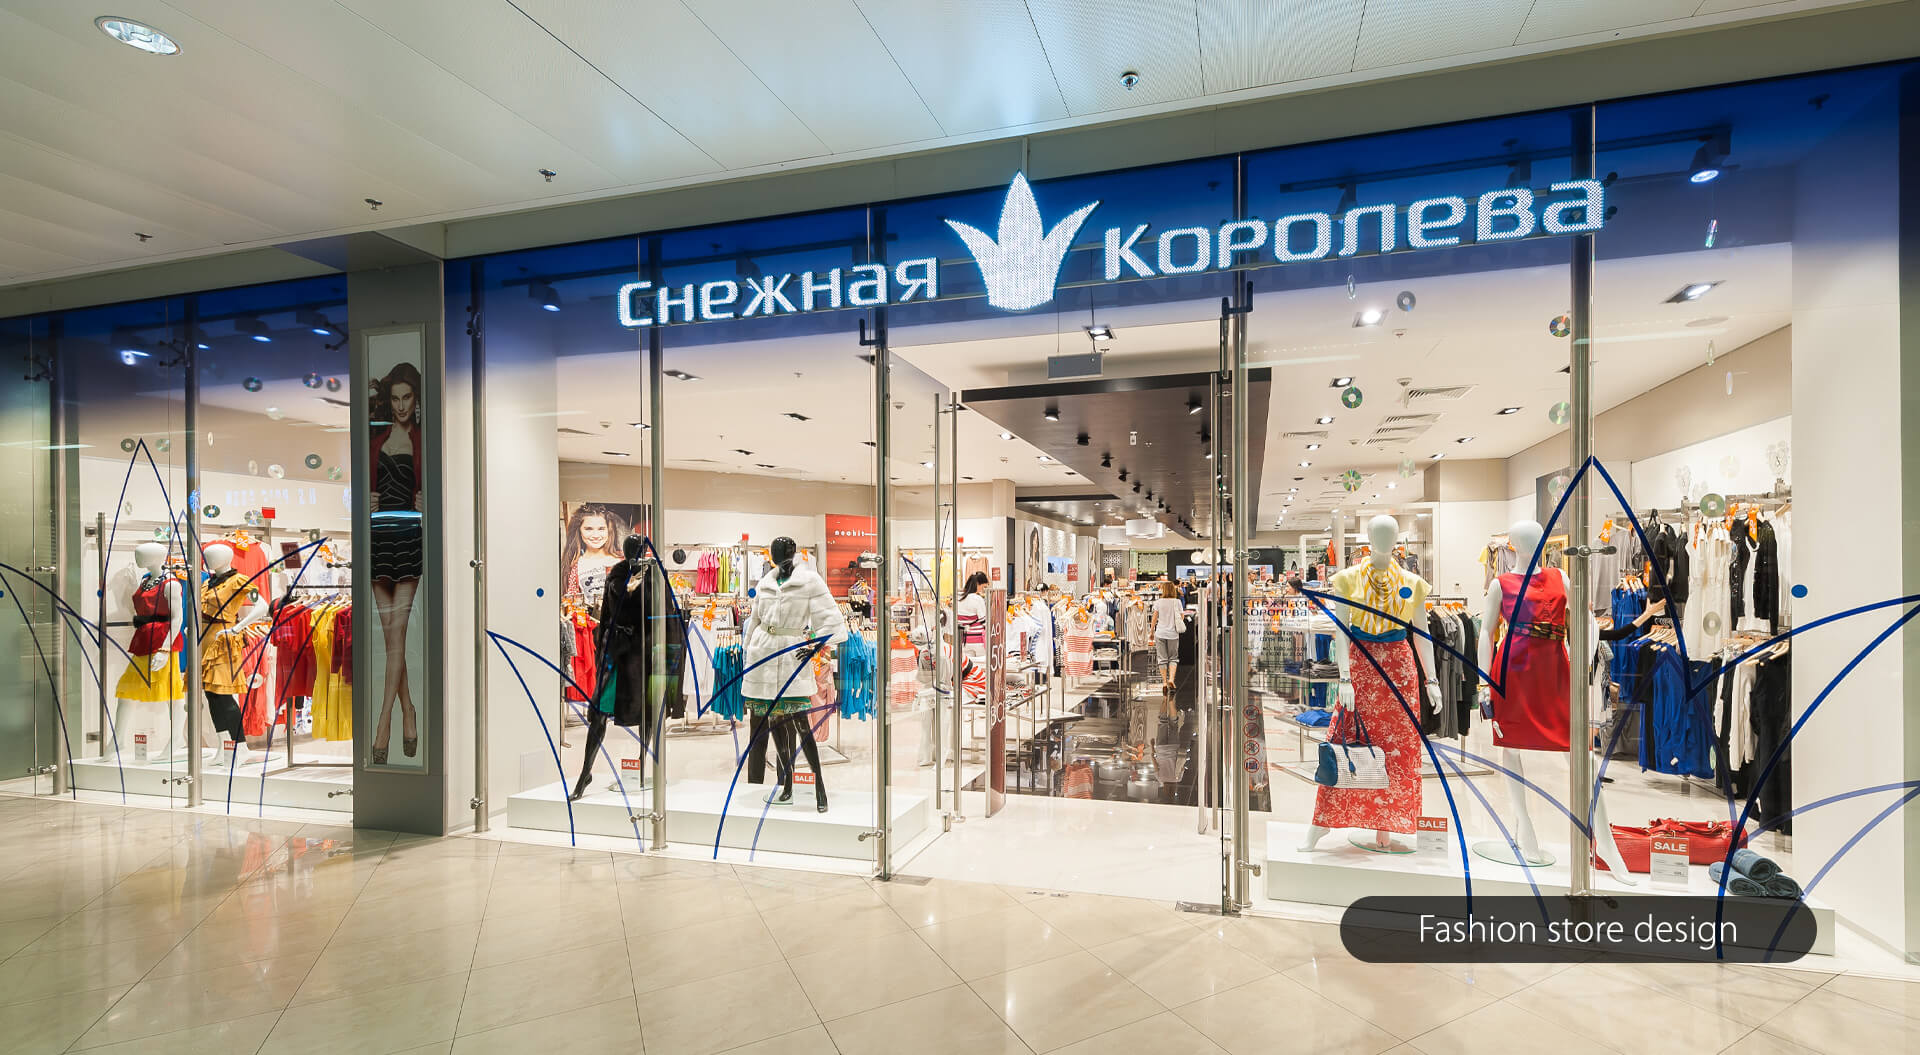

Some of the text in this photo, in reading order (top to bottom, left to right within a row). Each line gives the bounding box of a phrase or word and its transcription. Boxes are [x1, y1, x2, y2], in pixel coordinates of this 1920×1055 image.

[617, 178, 1604, 327] Снежная Королева
[794, 775, 814, 783] SALE
[1418, 820, 1446, 829] SALE
[1653, 841, 1688, 853] SALE
